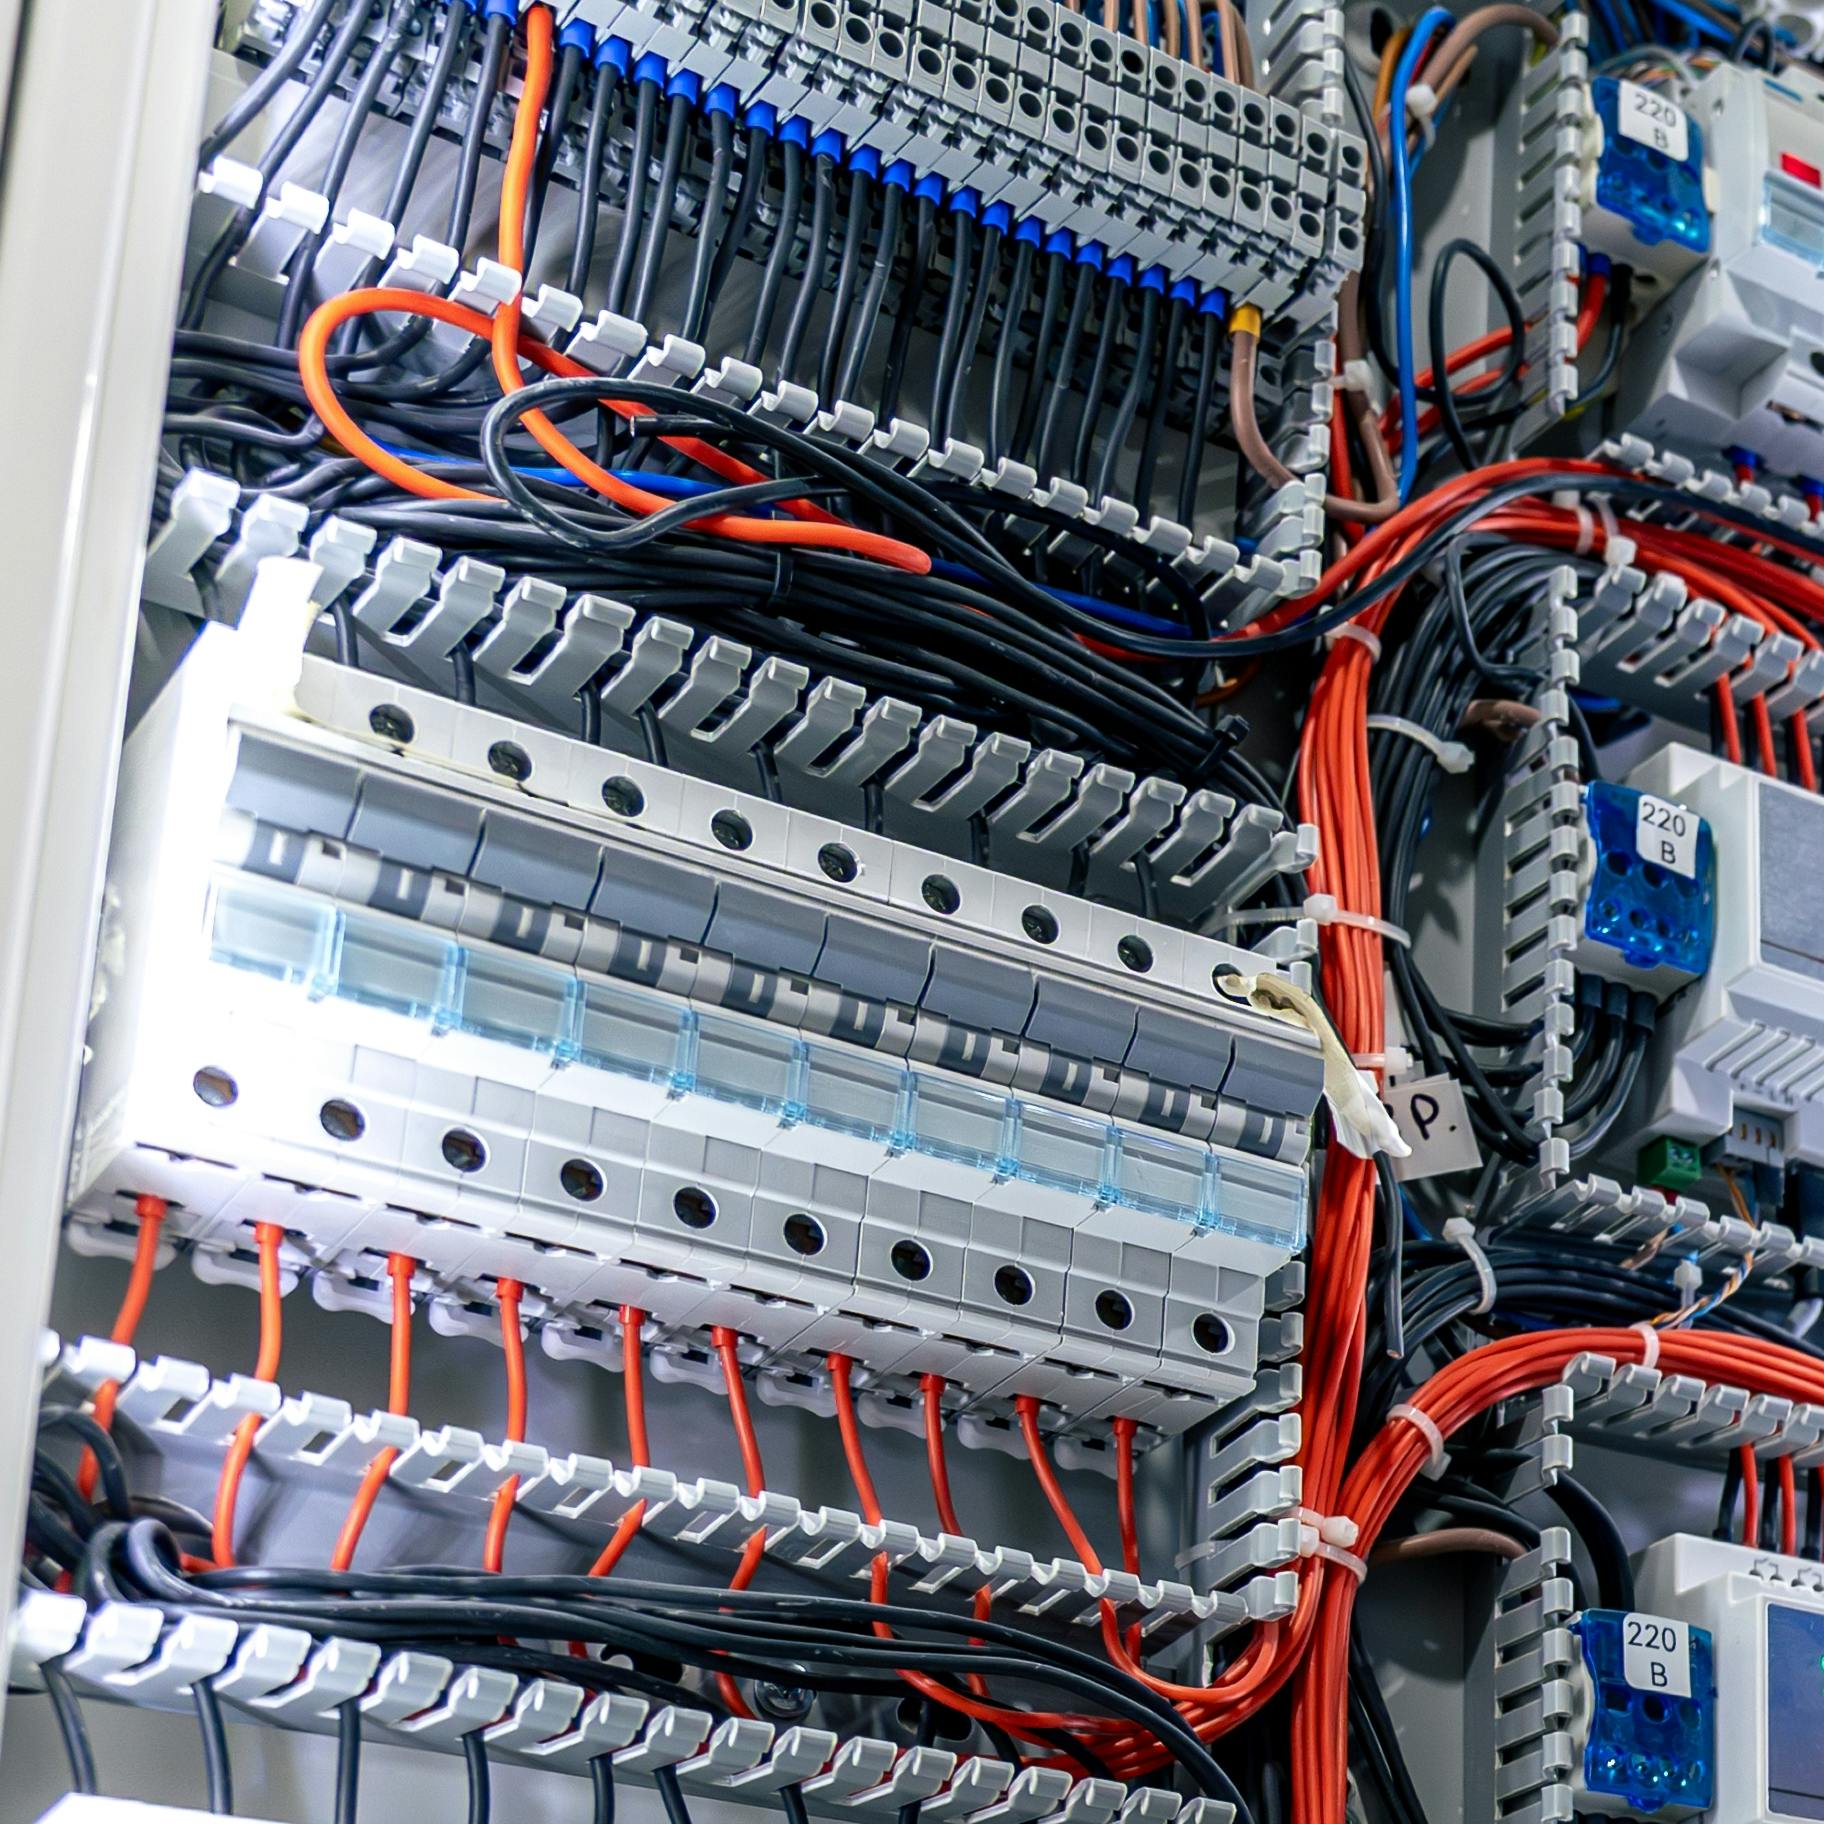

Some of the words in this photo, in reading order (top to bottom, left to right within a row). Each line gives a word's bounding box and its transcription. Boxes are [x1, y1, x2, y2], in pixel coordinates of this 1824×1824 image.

[1634, 92, 1677, 128] 220
[1642, 801, 1686, 837] 220
[1627, 1621, 1677, 1652] 220
